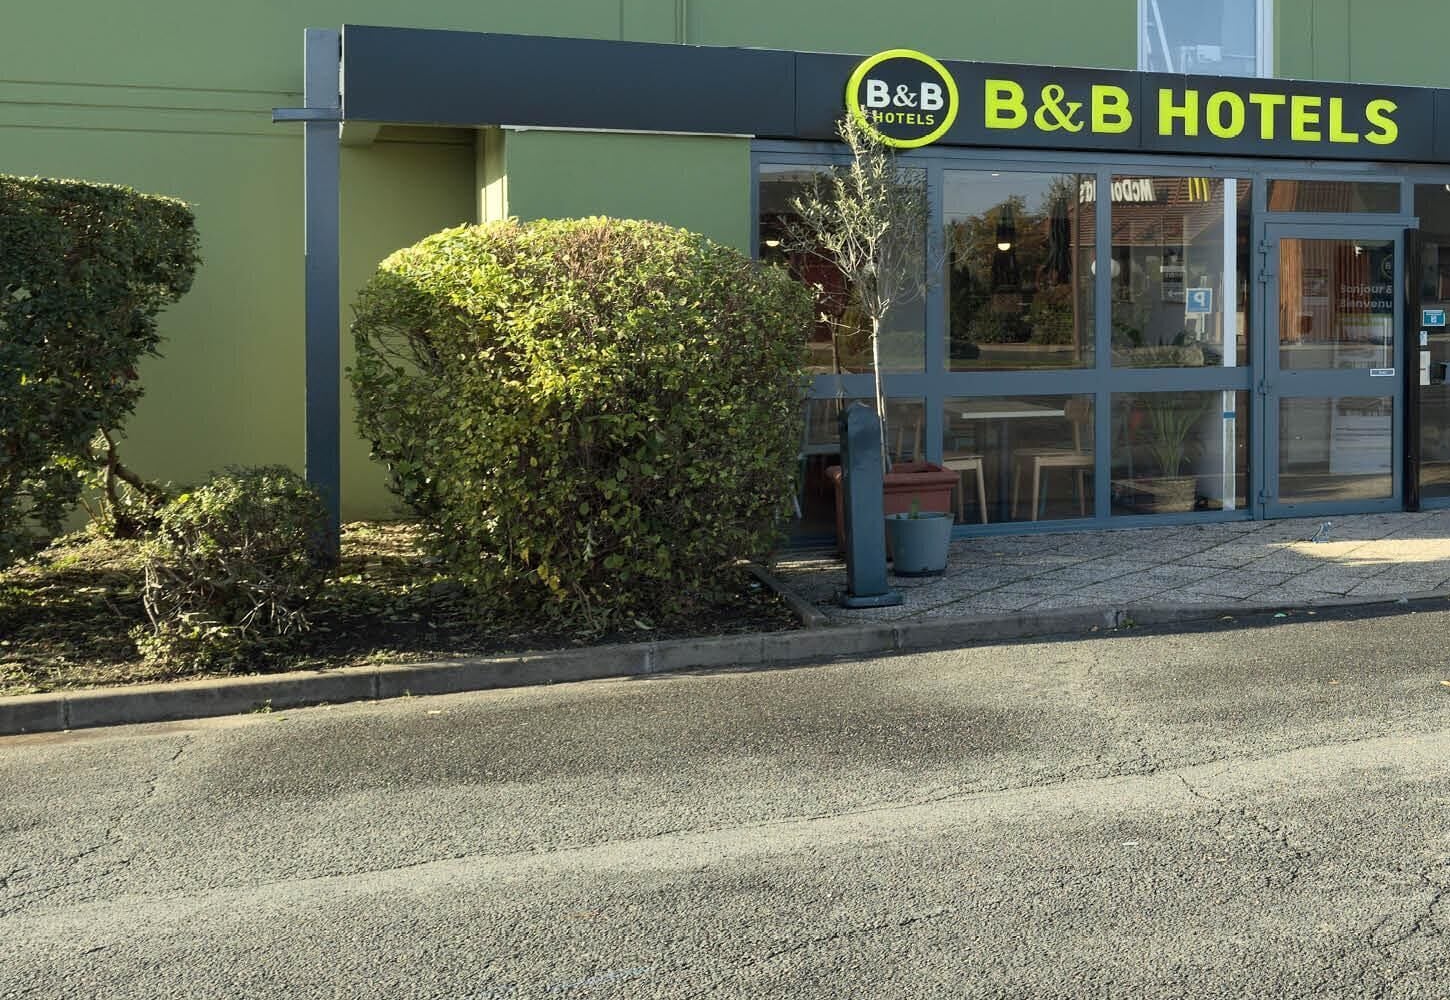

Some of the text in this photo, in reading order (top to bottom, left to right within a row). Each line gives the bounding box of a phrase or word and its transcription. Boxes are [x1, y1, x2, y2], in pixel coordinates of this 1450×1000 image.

[866, 79, 944, 111] B&B
[874, 112, 935, 126] HOTELS
[984, 79, 1399, 145] B&B HOTELS
